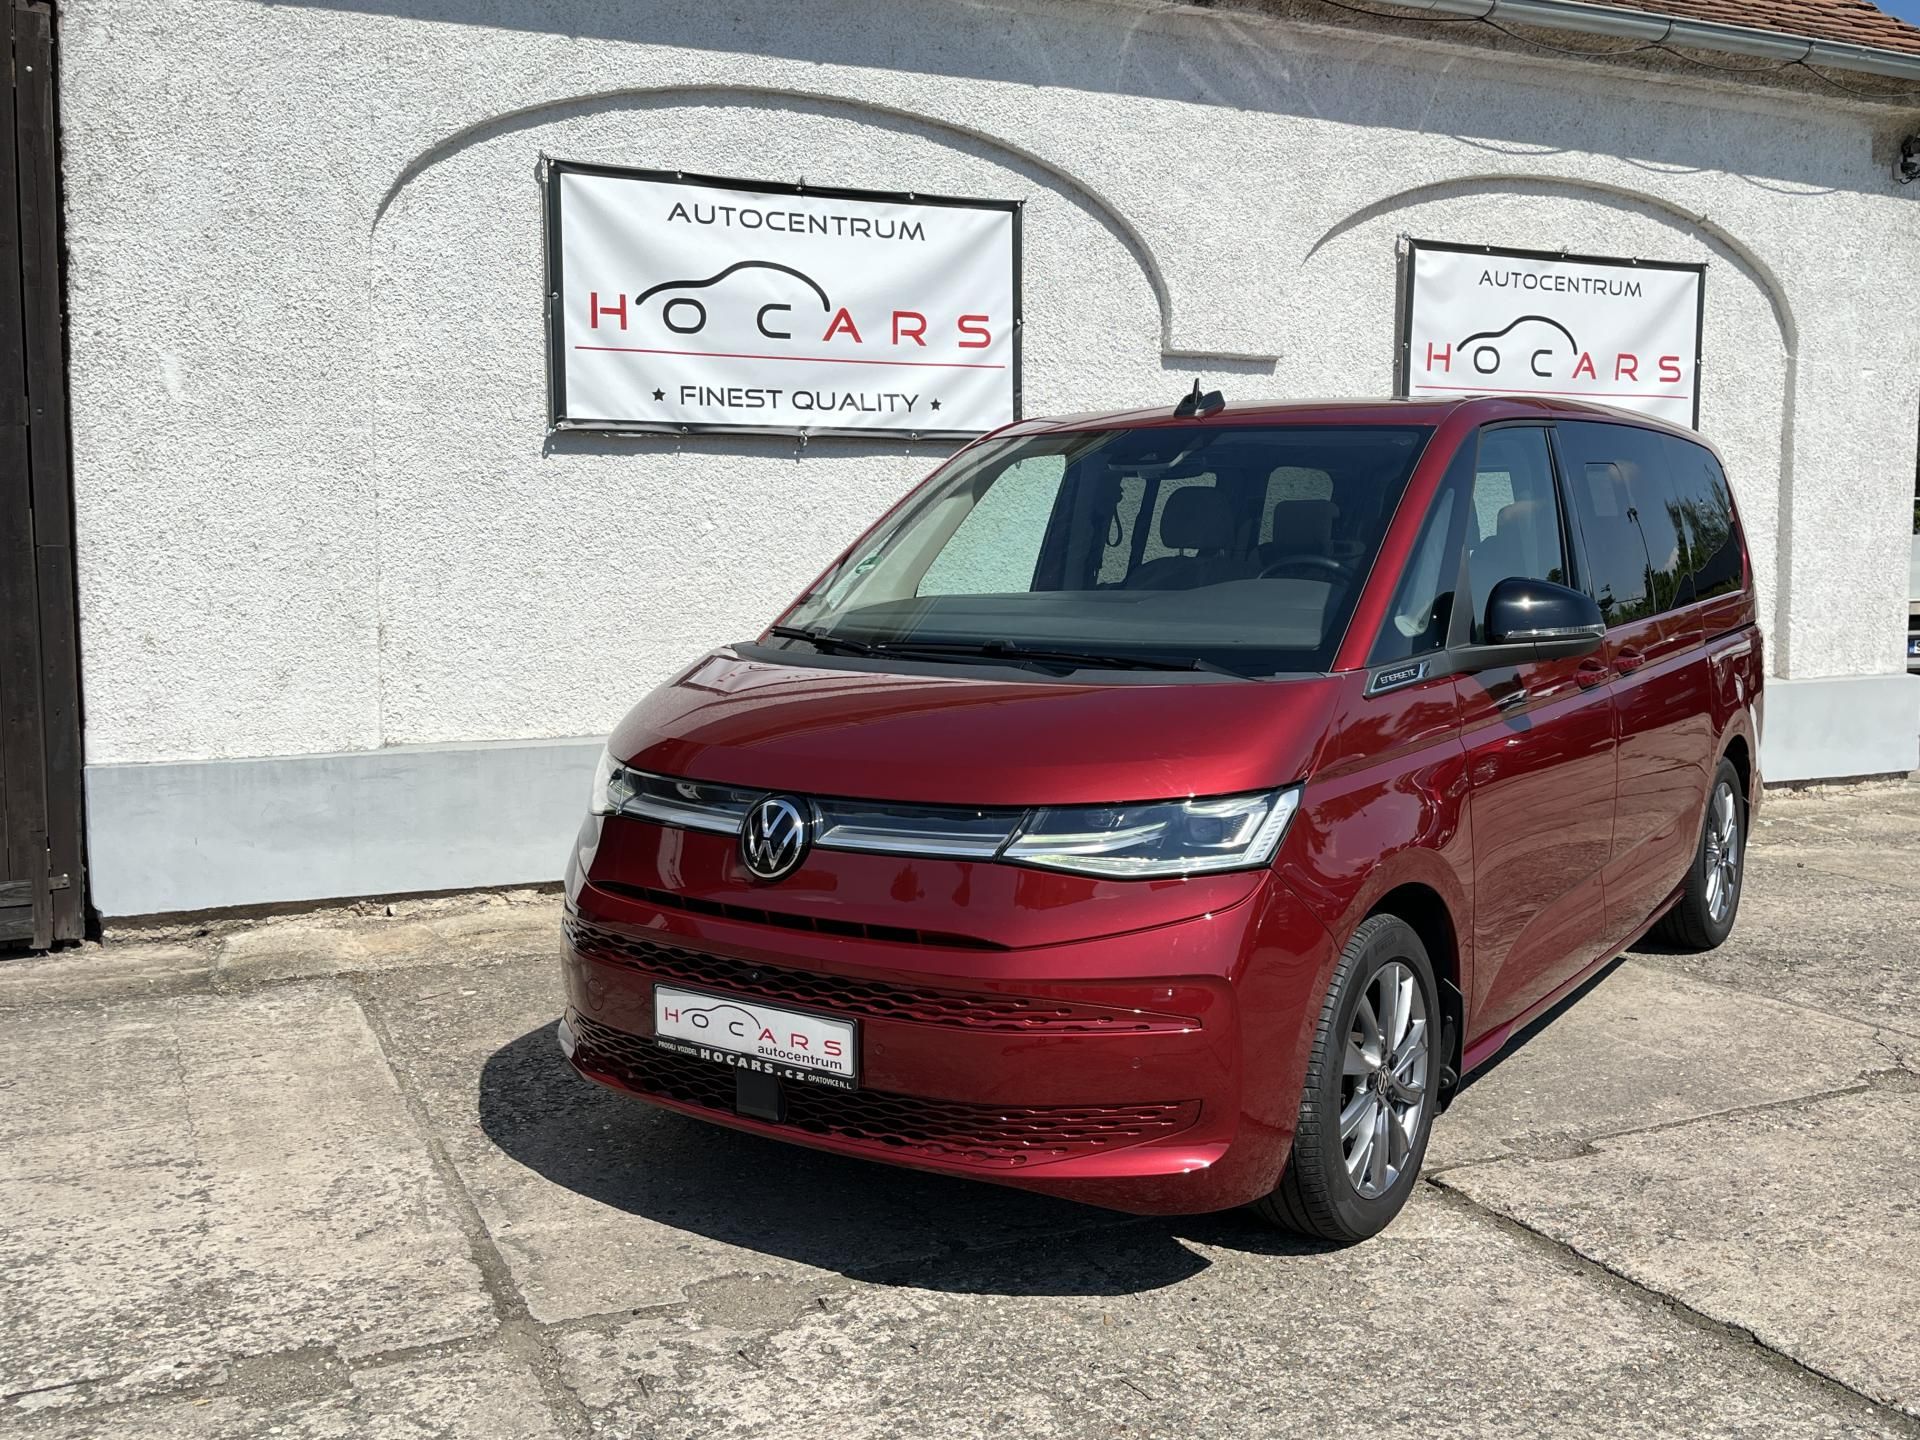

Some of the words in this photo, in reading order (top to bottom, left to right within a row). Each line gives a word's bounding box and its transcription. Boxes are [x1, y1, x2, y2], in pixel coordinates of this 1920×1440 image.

[667, 202, 925, 241] AUTOCENTRUM
[1479, 270, 1642, 297] AUTOCENTRUM
[680, 385, 783, 410] FINEST
[792, 391, 919, 414] QUALITY
[1381, 669, 1416, 683] ENERGETIC
[757, 1045, 842, 1070] autocentrum
[807, 1074, 839, 1087] OPATOVICE
